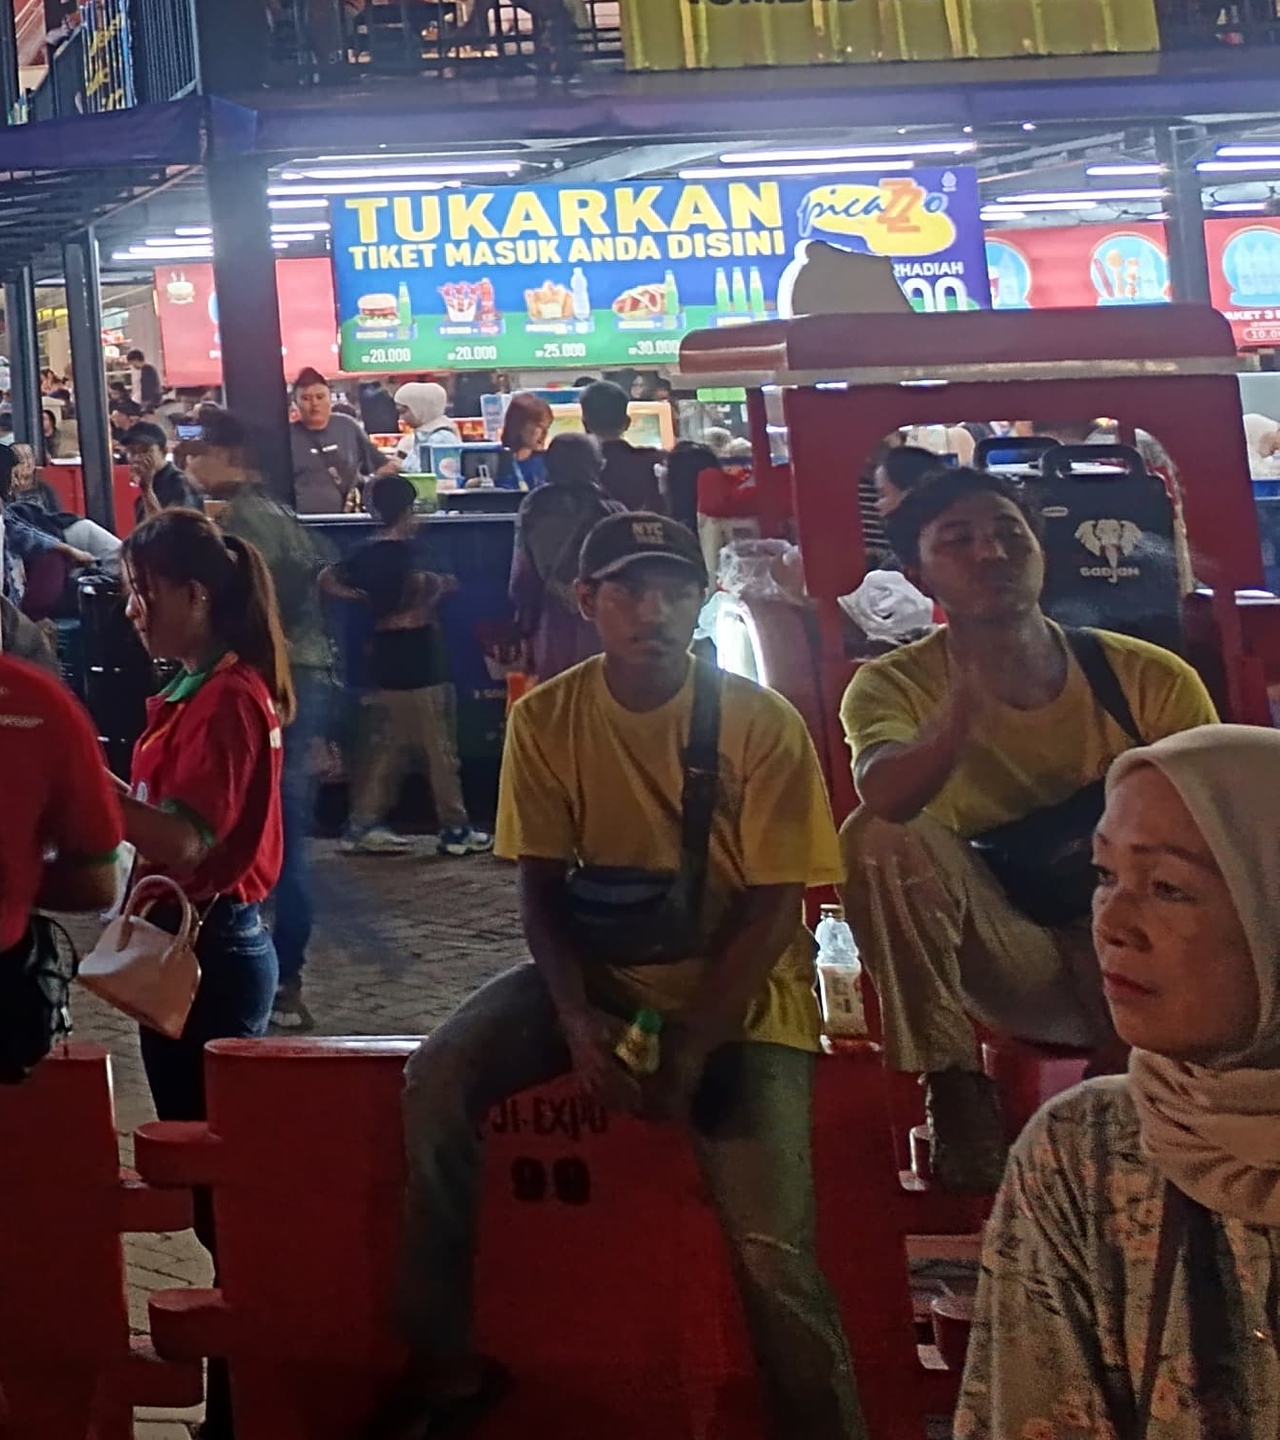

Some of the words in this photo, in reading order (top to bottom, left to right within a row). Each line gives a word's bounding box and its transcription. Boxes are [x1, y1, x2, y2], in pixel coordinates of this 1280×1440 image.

[345, 181, 782, 243] TUKARKAN
[348, 243, 437, 270] TIKET
[445, 239, 561, 266] MASUK
[568, 235, 659, 263] ANDA
[667, 229, 785, 259] DISINI
